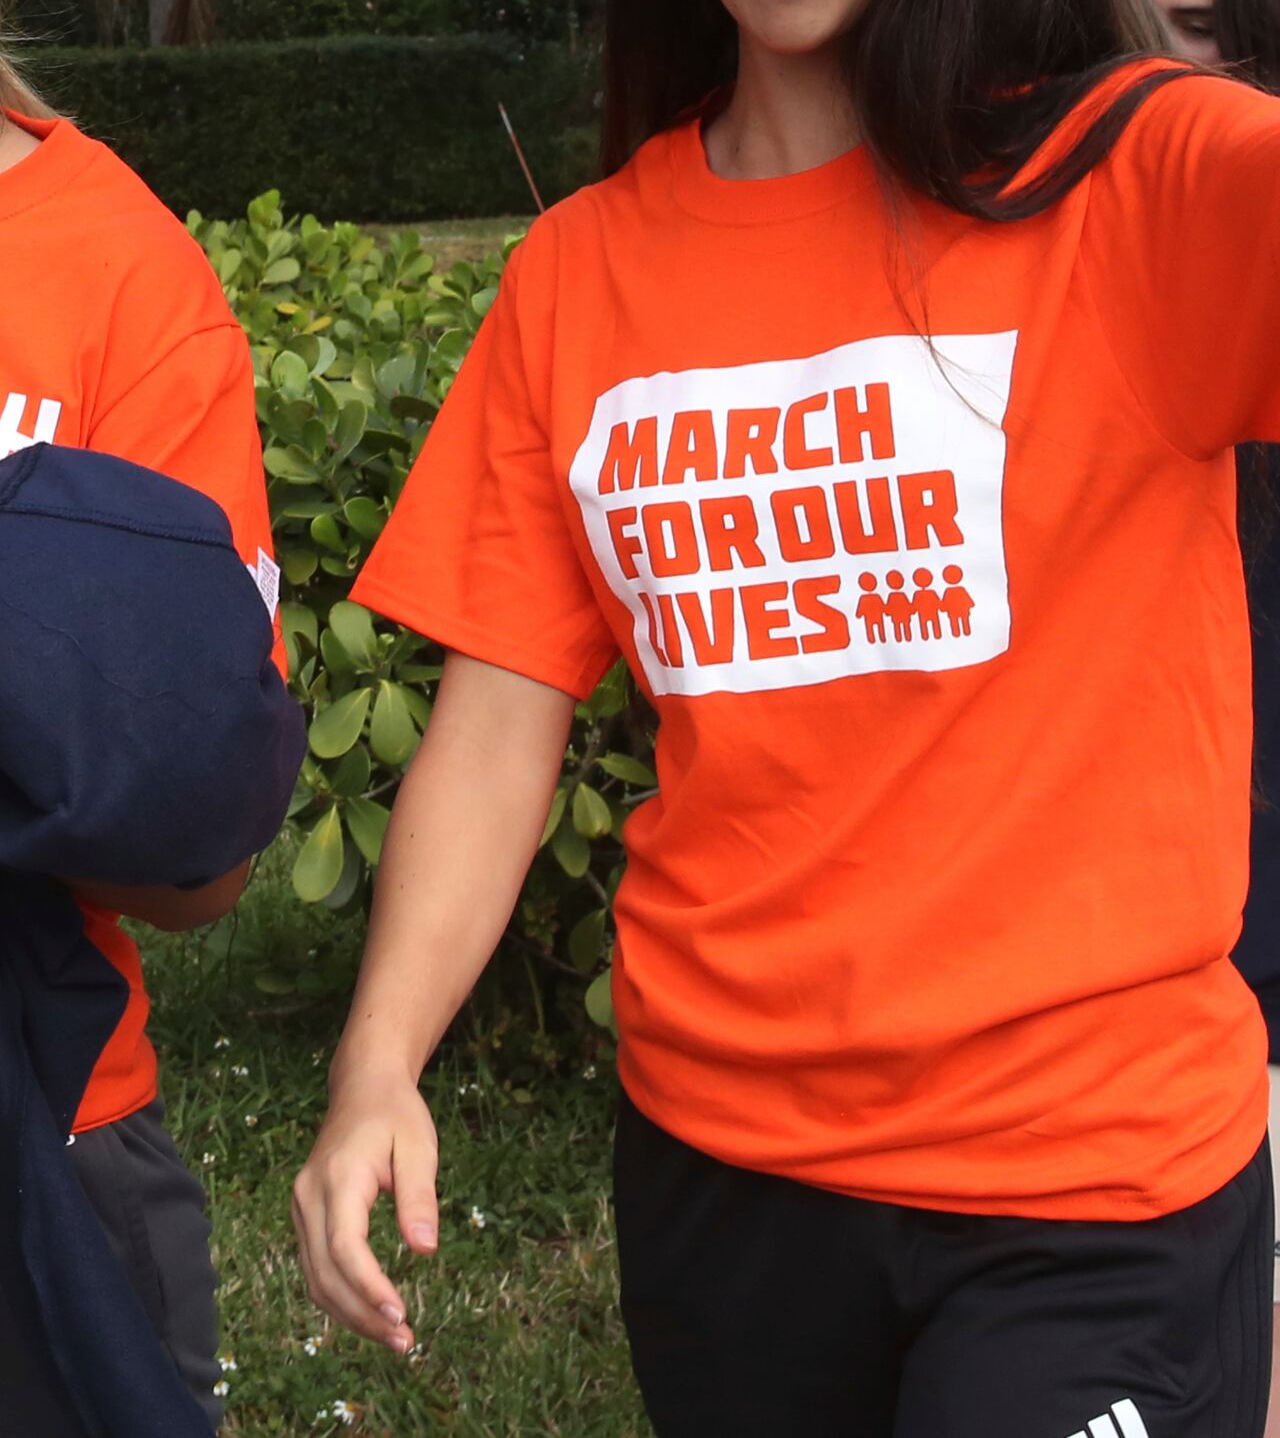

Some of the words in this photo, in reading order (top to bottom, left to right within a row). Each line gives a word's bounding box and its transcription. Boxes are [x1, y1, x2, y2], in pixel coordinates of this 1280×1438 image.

[598, 382, 896, 495] MARCH
[605, 495, 766, 581] FOR
[770, 470, 964, 563] OUR
[638, 574, 851, 669] LIVES
